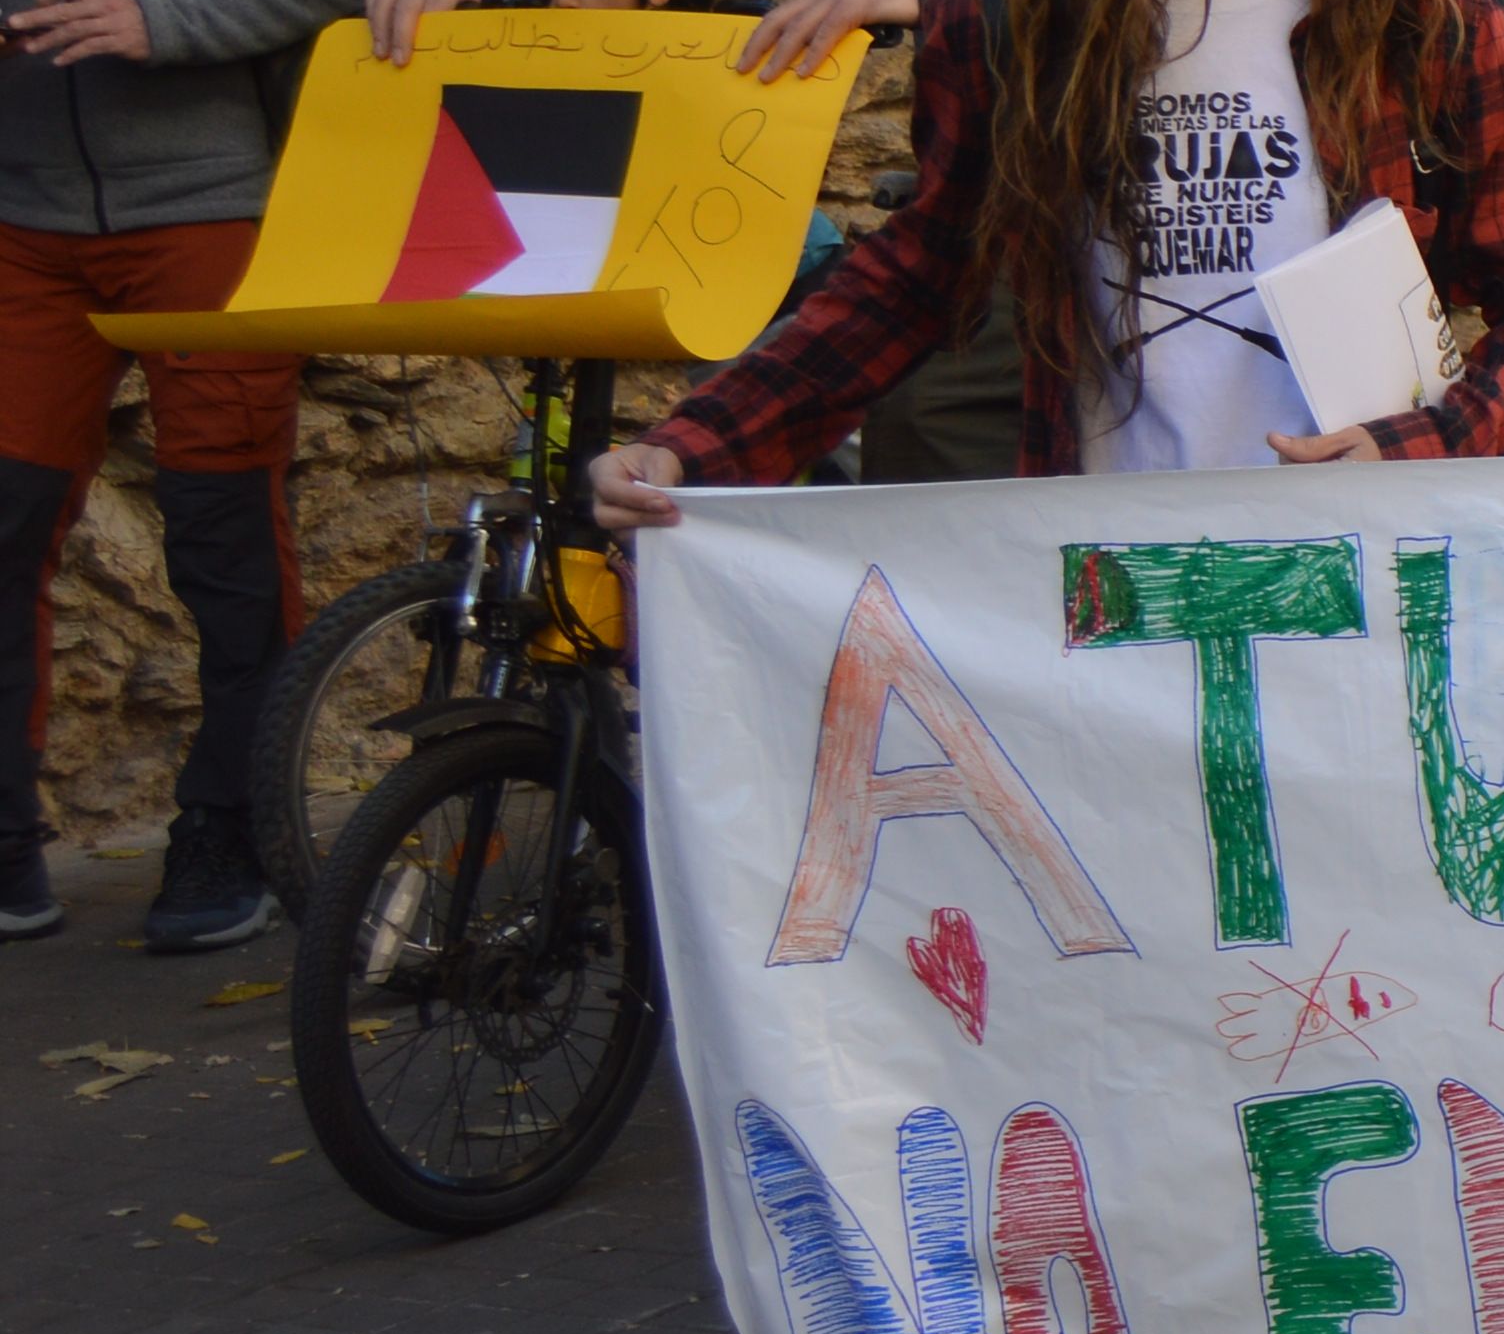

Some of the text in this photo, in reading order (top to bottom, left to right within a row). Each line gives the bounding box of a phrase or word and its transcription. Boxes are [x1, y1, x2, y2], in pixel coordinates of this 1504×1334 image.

[1137, 92, 1251, 117] SOMOS
[1142, 115, 1209, 133] NIETAS
[1216, 115, 1242, 130] DE
[1250, 115, 1285, 130] LAS
[1177, 180, 1286, 204] NUNCA
[1137, 226, 1255, 278] QUEMAR
